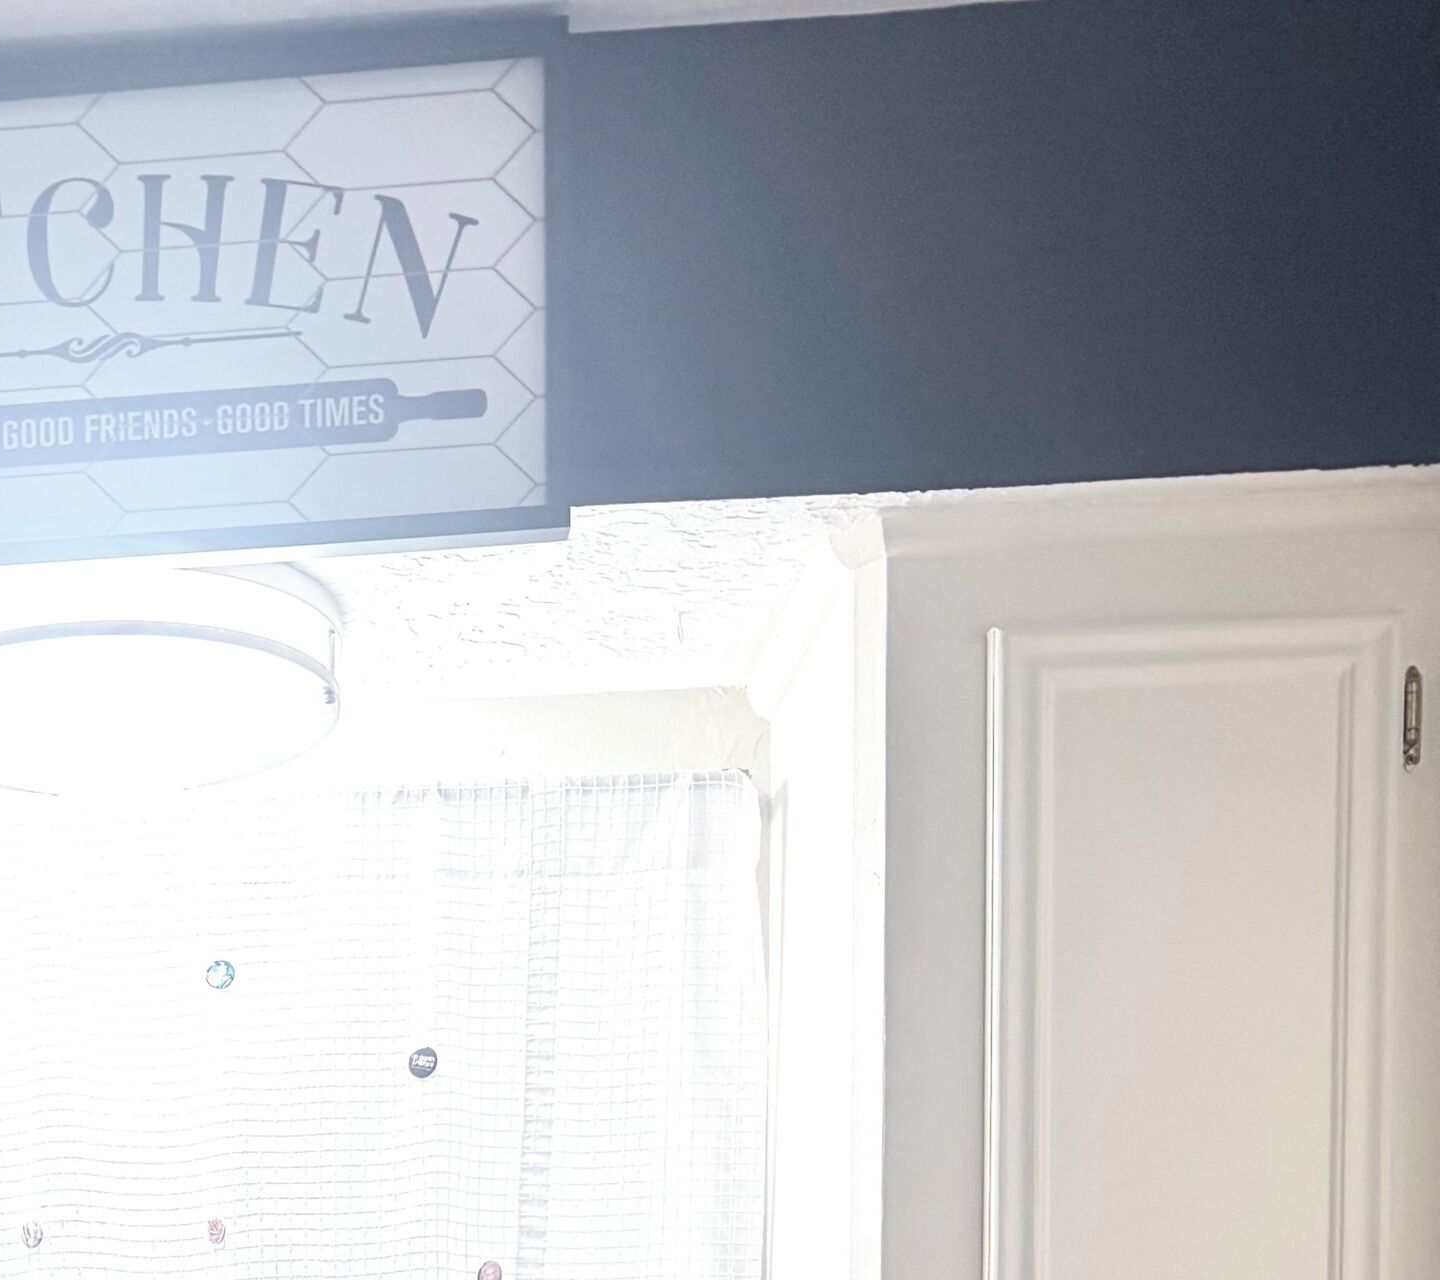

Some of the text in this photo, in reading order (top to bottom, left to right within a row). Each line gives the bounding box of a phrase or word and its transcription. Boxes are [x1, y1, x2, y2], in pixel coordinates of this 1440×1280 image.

[2, 417, 74, 450] GOOD
[85, 407, 198, 444] FRIENDS
[217, 401, 290, 434] GOOD
[299, 394, 385, 429] TIMES
